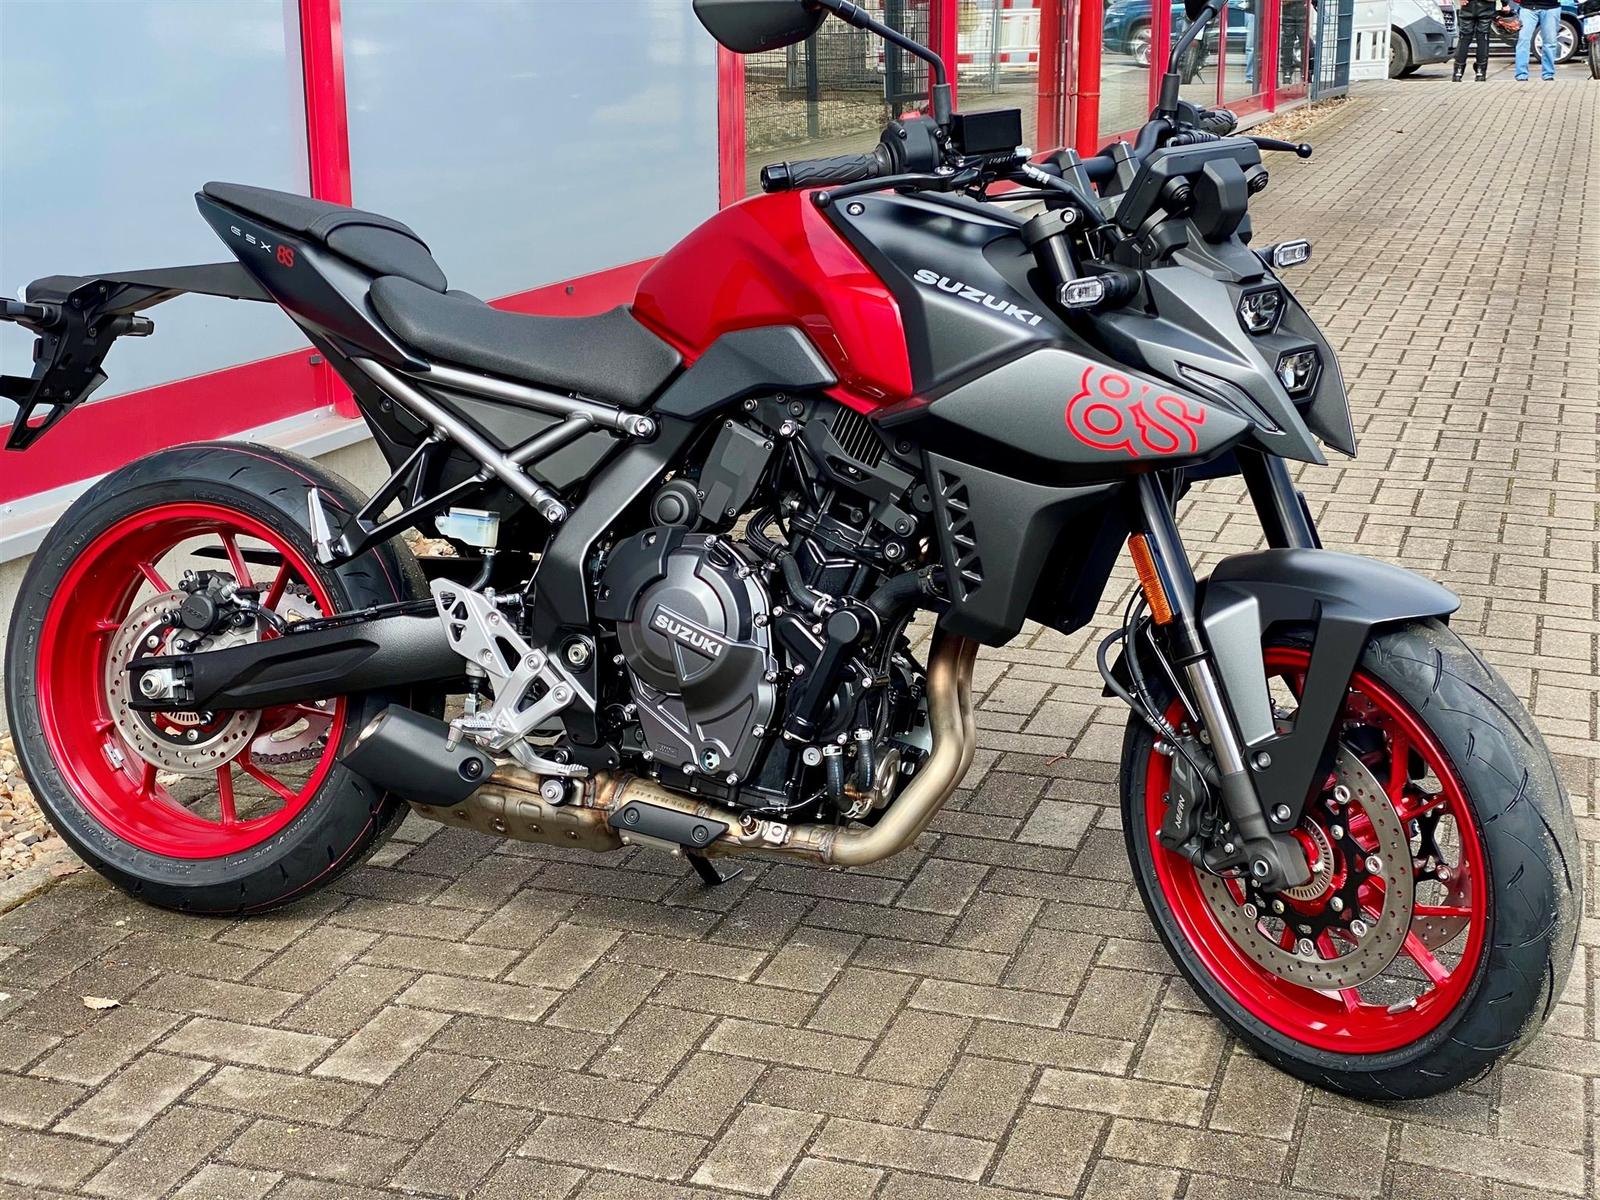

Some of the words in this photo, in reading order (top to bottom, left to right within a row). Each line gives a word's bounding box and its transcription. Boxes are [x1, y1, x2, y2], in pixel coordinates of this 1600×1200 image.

[276, 244, 295, 268] 8S
[913, 269, 1043, 326] SUZUKI
[654, 614, 724, 657] SUZUKI
